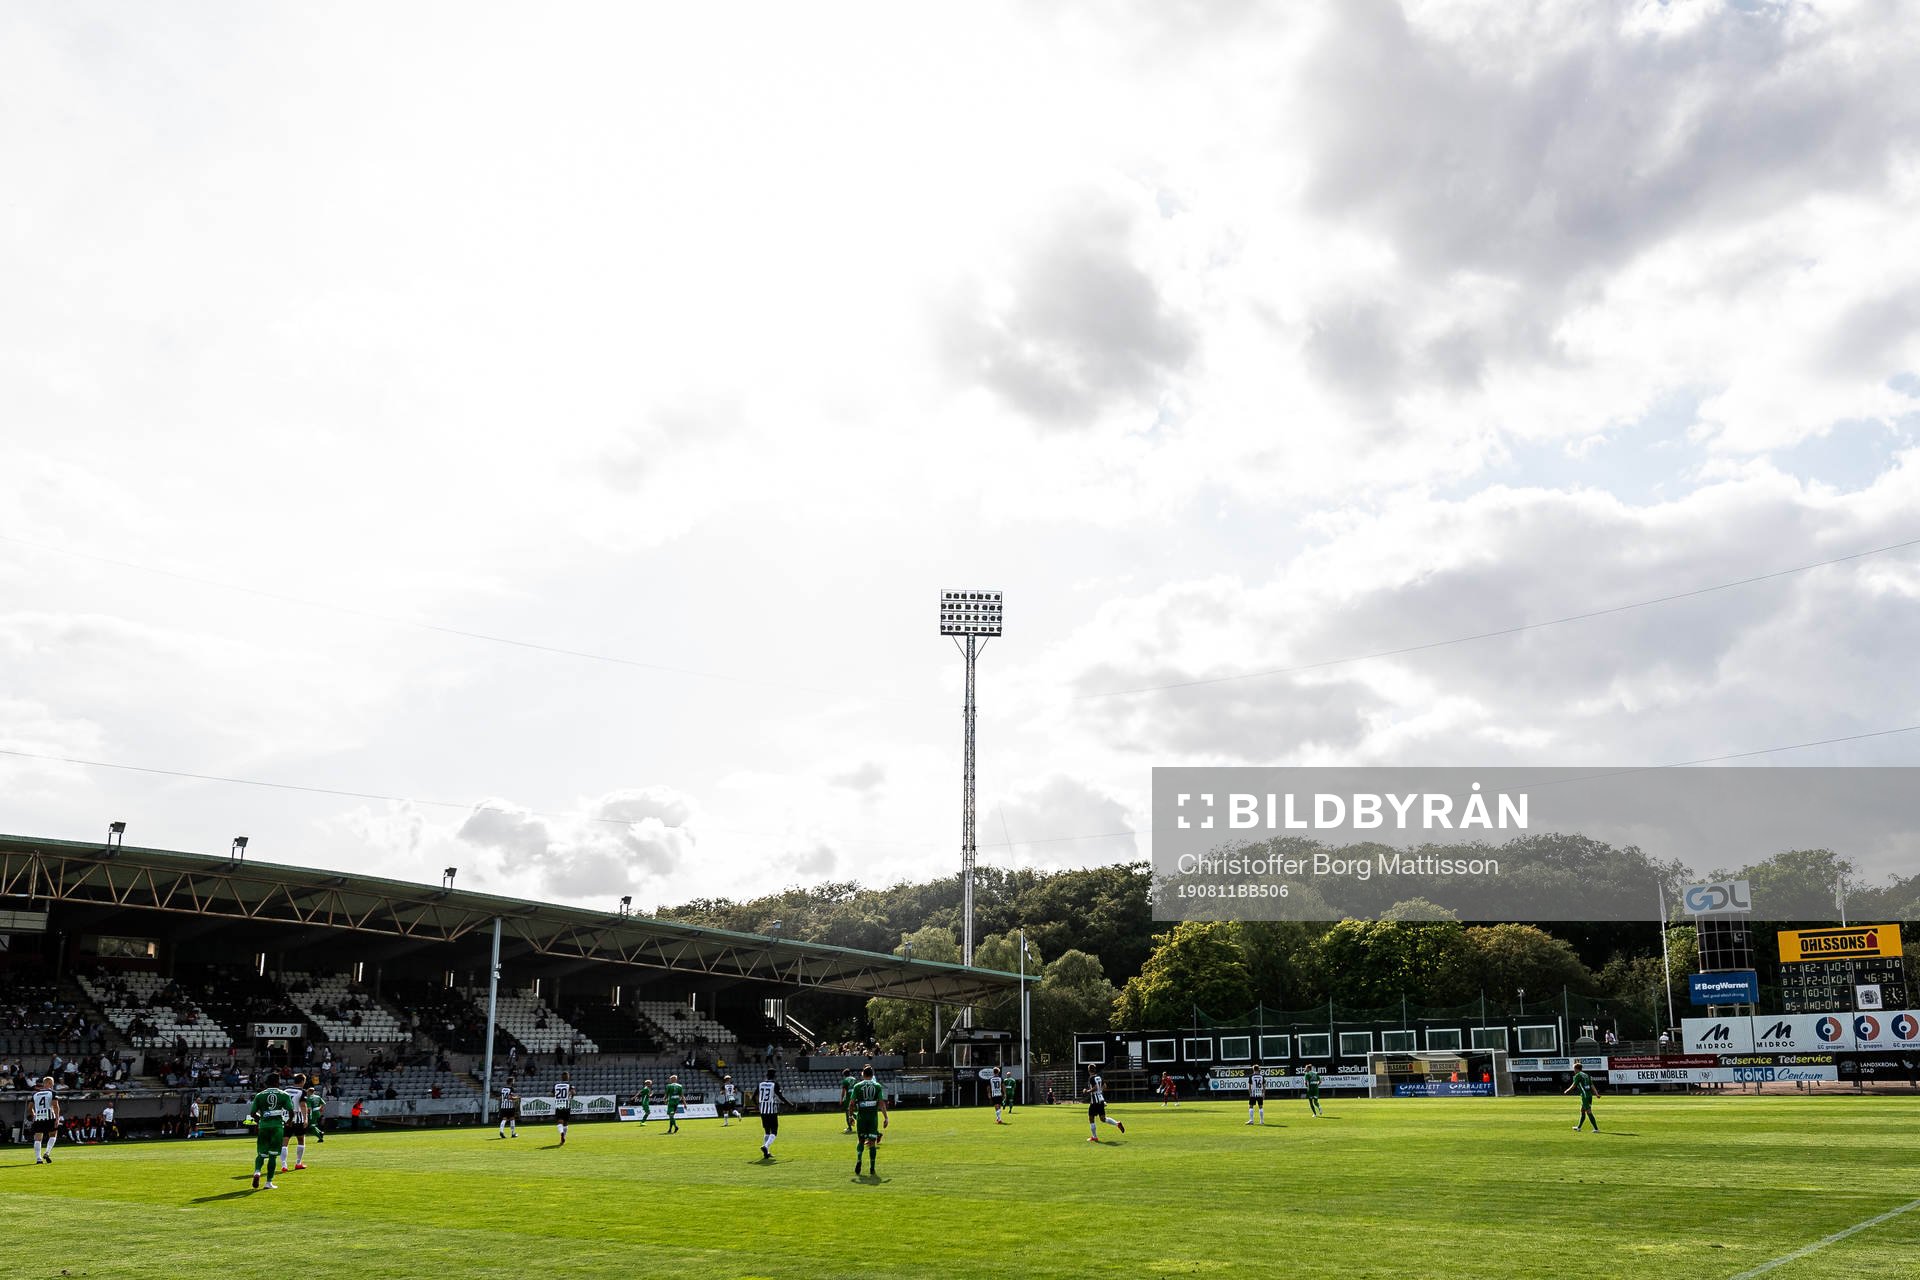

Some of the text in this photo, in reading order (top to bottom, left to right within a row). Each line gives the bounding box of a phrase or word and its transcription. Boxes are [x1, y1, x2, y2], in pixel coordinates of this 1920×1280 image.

[1686, 885, 1749, 911] GDL
[1800, 936, 1866, 952] OHLSSONS
[1864, 973, 1895, 983] 46:34
[268, 1026, 287, 1035] VIP
[1695, 1042, 1734, 1050] MIDROC
[1756, 1040, 1795, 1048] MIDROC
[1720, 1056, 1772, 1065] Tedservice
[1778, 1054, 1833, 1064] Tedservice
[1215, 1069, 1245, 1077] Tedsys
[1637, 1069, 1688, 1080] EKEBY MÖBLER
[1734, 1067, 1823, 1081] KÖKS Centrum
[1219, 1079, 1247, 1089] Brinova
[1254, 1079, 1262, 1088] 16
[556, 1088, 567, 1099] 20
[861, 1085, 876, 1101] 10
[38, 1096, 46, 1109] 4
[267, 1093, 278, 1110] 9
